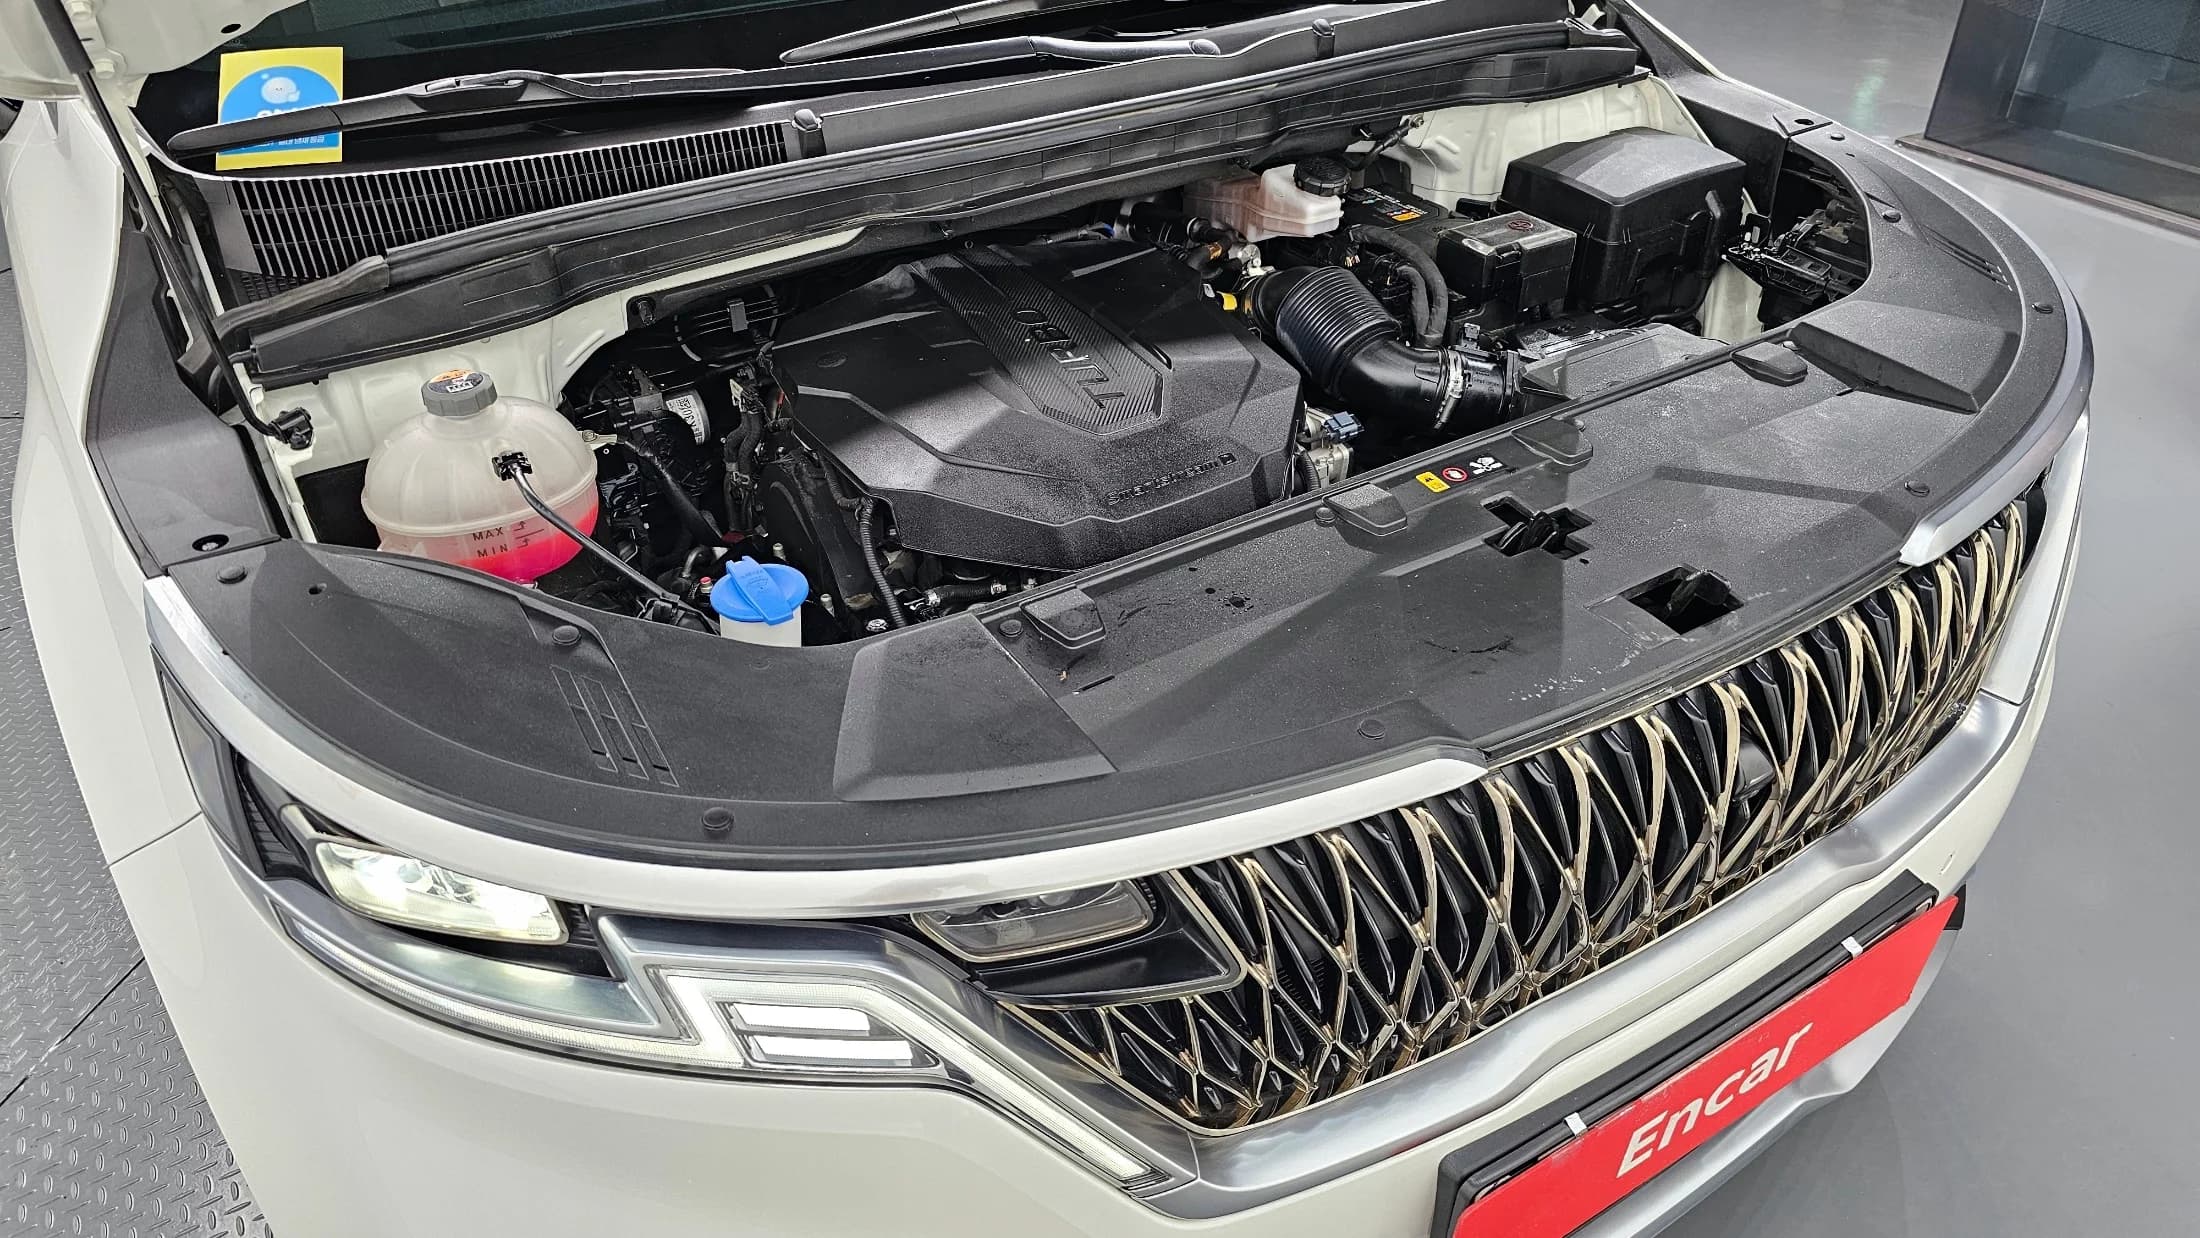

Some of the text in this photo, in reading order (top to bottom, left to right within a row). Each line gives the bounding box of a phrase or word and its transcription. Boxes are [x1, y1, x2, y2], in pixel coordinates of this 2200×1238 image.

[1010, 308, 1126, 409] TURBO
[1106, 460, 1220, 506] Smartstream
[472, 526, 504, 541] MAX
[476, 543, 509, 558] MIN
[1616, 1022, 1814, 1179] Encar
